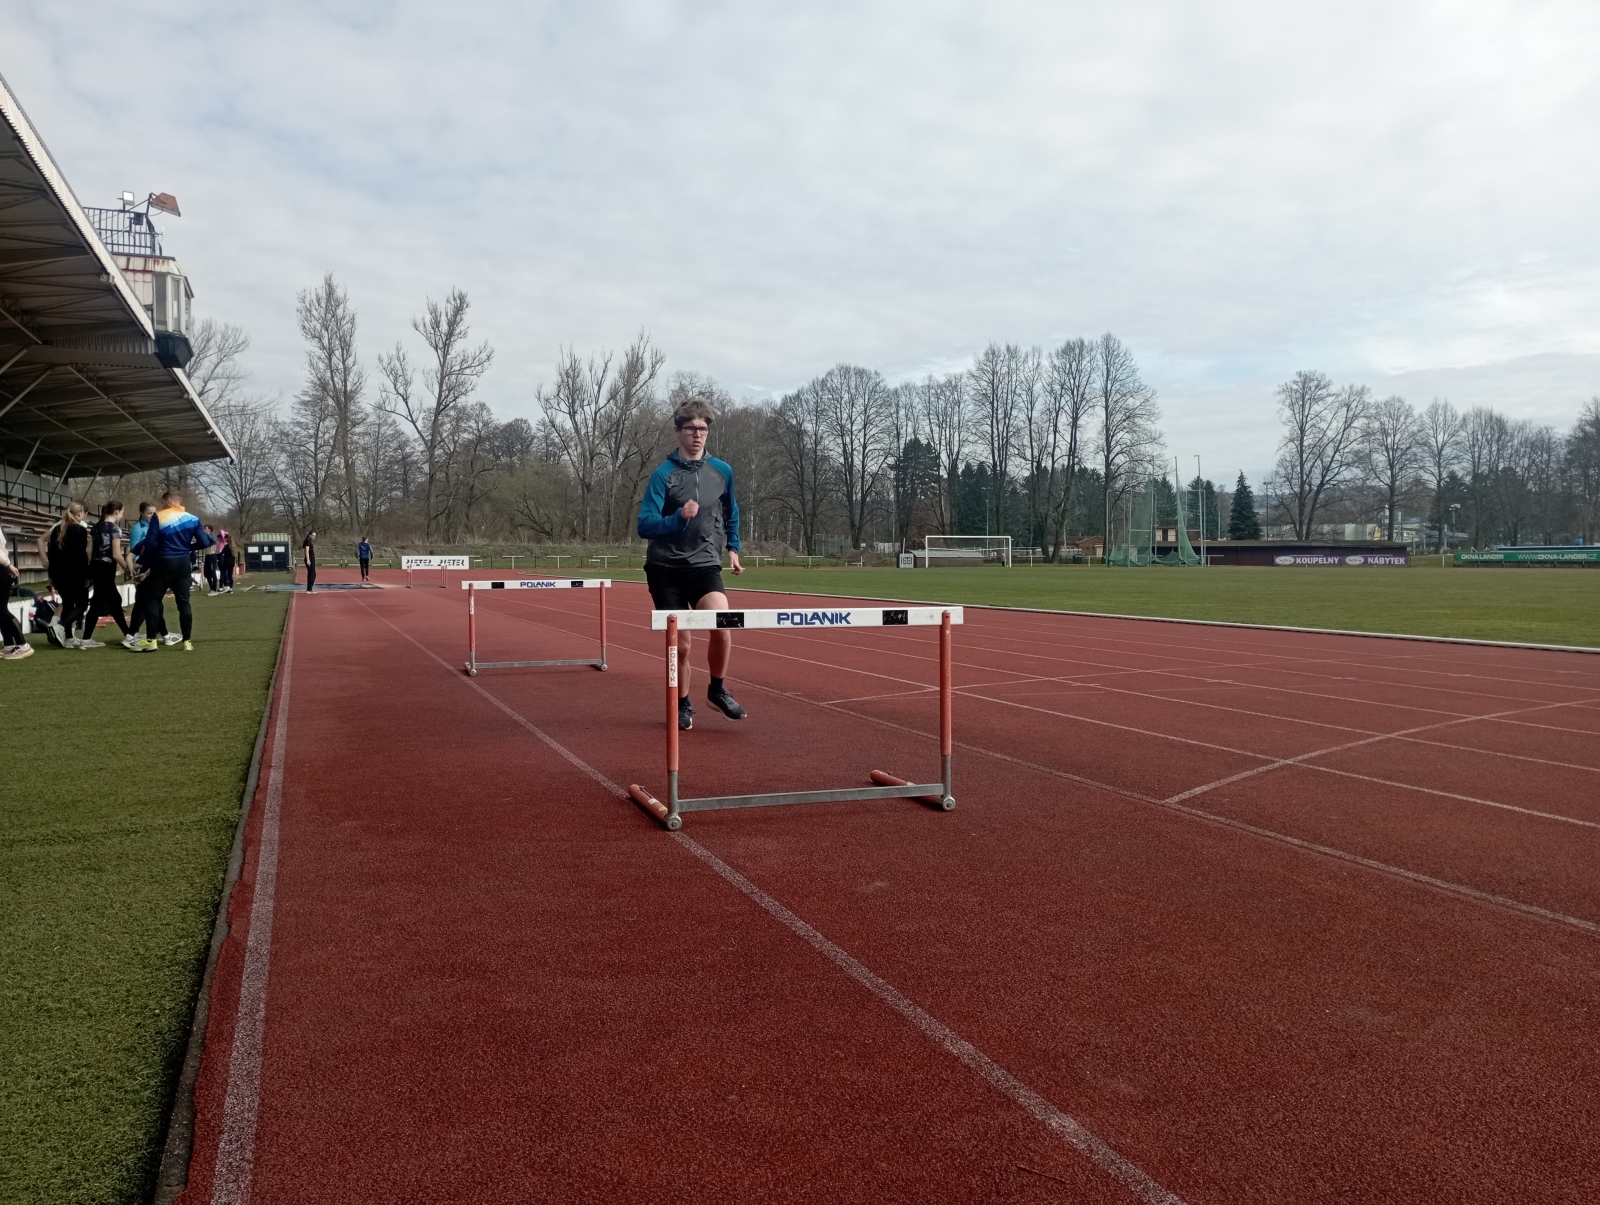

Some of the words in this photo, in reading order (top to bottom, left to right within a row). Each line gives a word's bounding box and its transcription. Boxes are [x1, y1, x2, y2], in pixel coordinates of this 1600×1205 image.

[1296, 556, 1340, 564] KOUPELNY
[1367, 555, 1406, 565] NÁBYTEK
[776, 611, 852, 625] POLANIK
